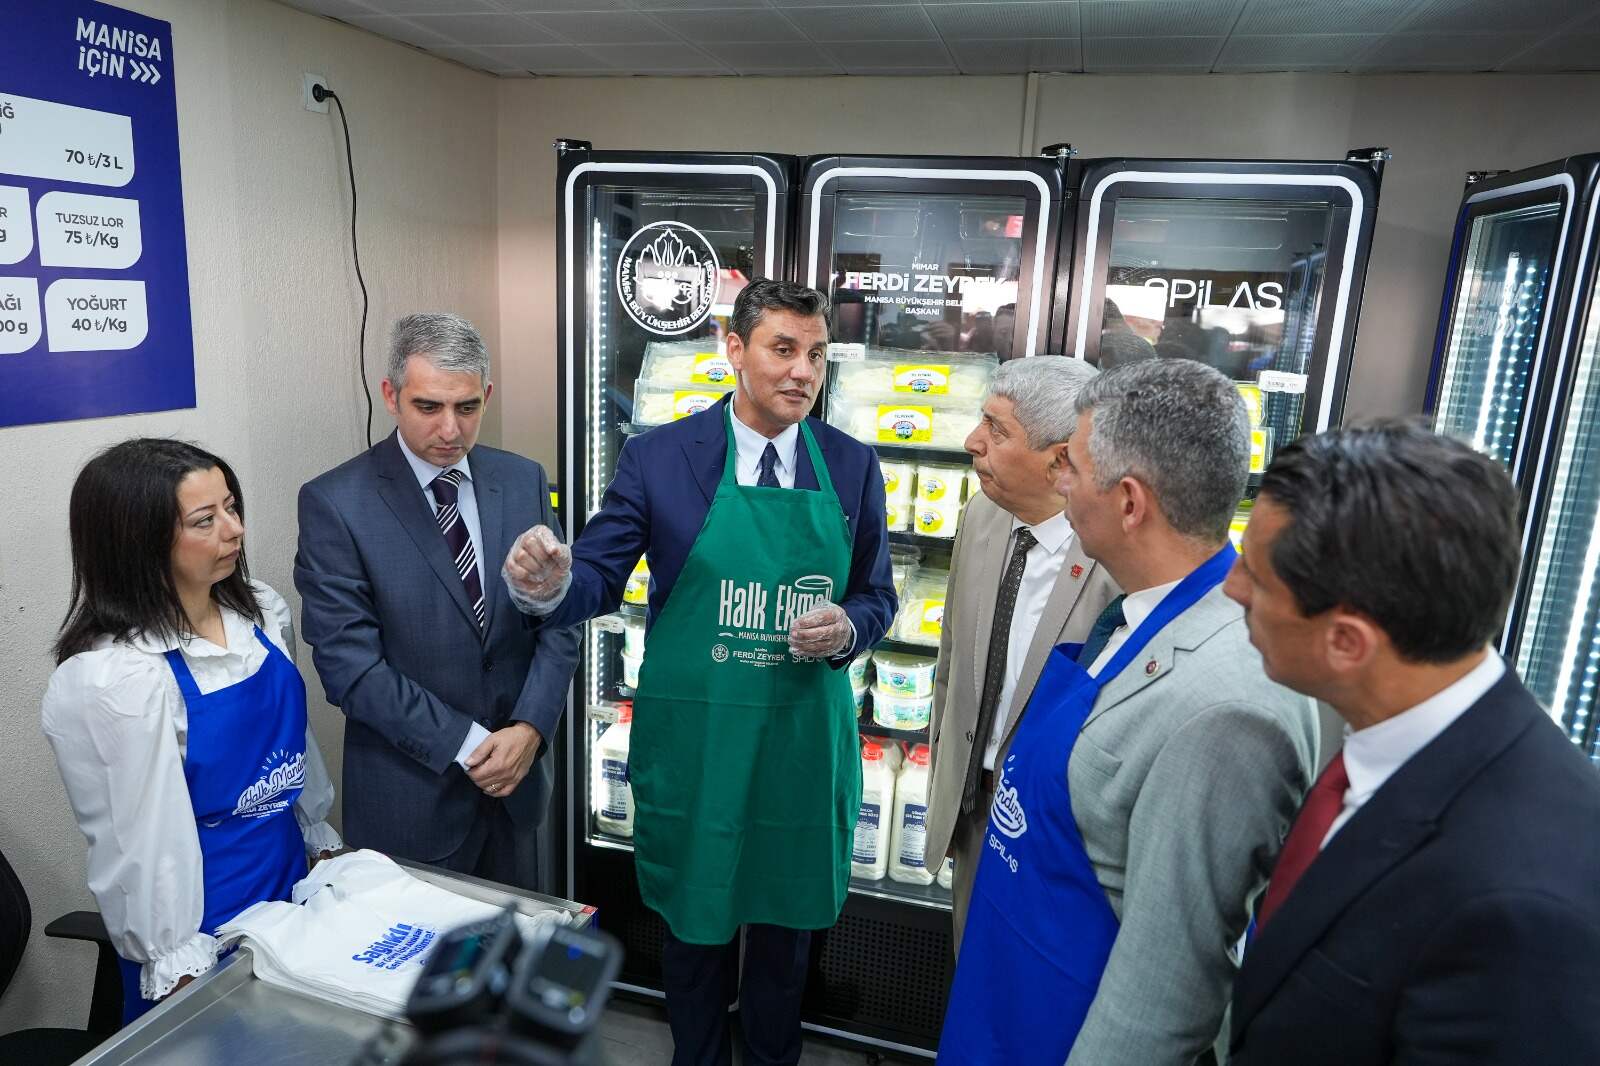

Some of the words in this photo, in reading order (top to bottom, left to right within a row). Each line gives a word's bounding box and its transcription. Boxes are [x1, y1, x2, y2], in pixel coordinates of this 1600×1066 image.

[65, 149, 85, 165] 70
[114, 156, 123, 170] L
[55, 212, 100, 227] TUZSUZ
[101, 215, 124, 228] LOR
[64, 230, 83, 245] 75
[66, 294, 128, 311] YOĞURT
[71, 318, 92, 331] 40
[718, 579, 768, 630] Halk
[775, 584, 832, 631] Ekm
[756, 652, 785, 662] ZEYREK
[239, 779, 271, 810] Halk
[257, 800, 289, 812] ZEYREK
